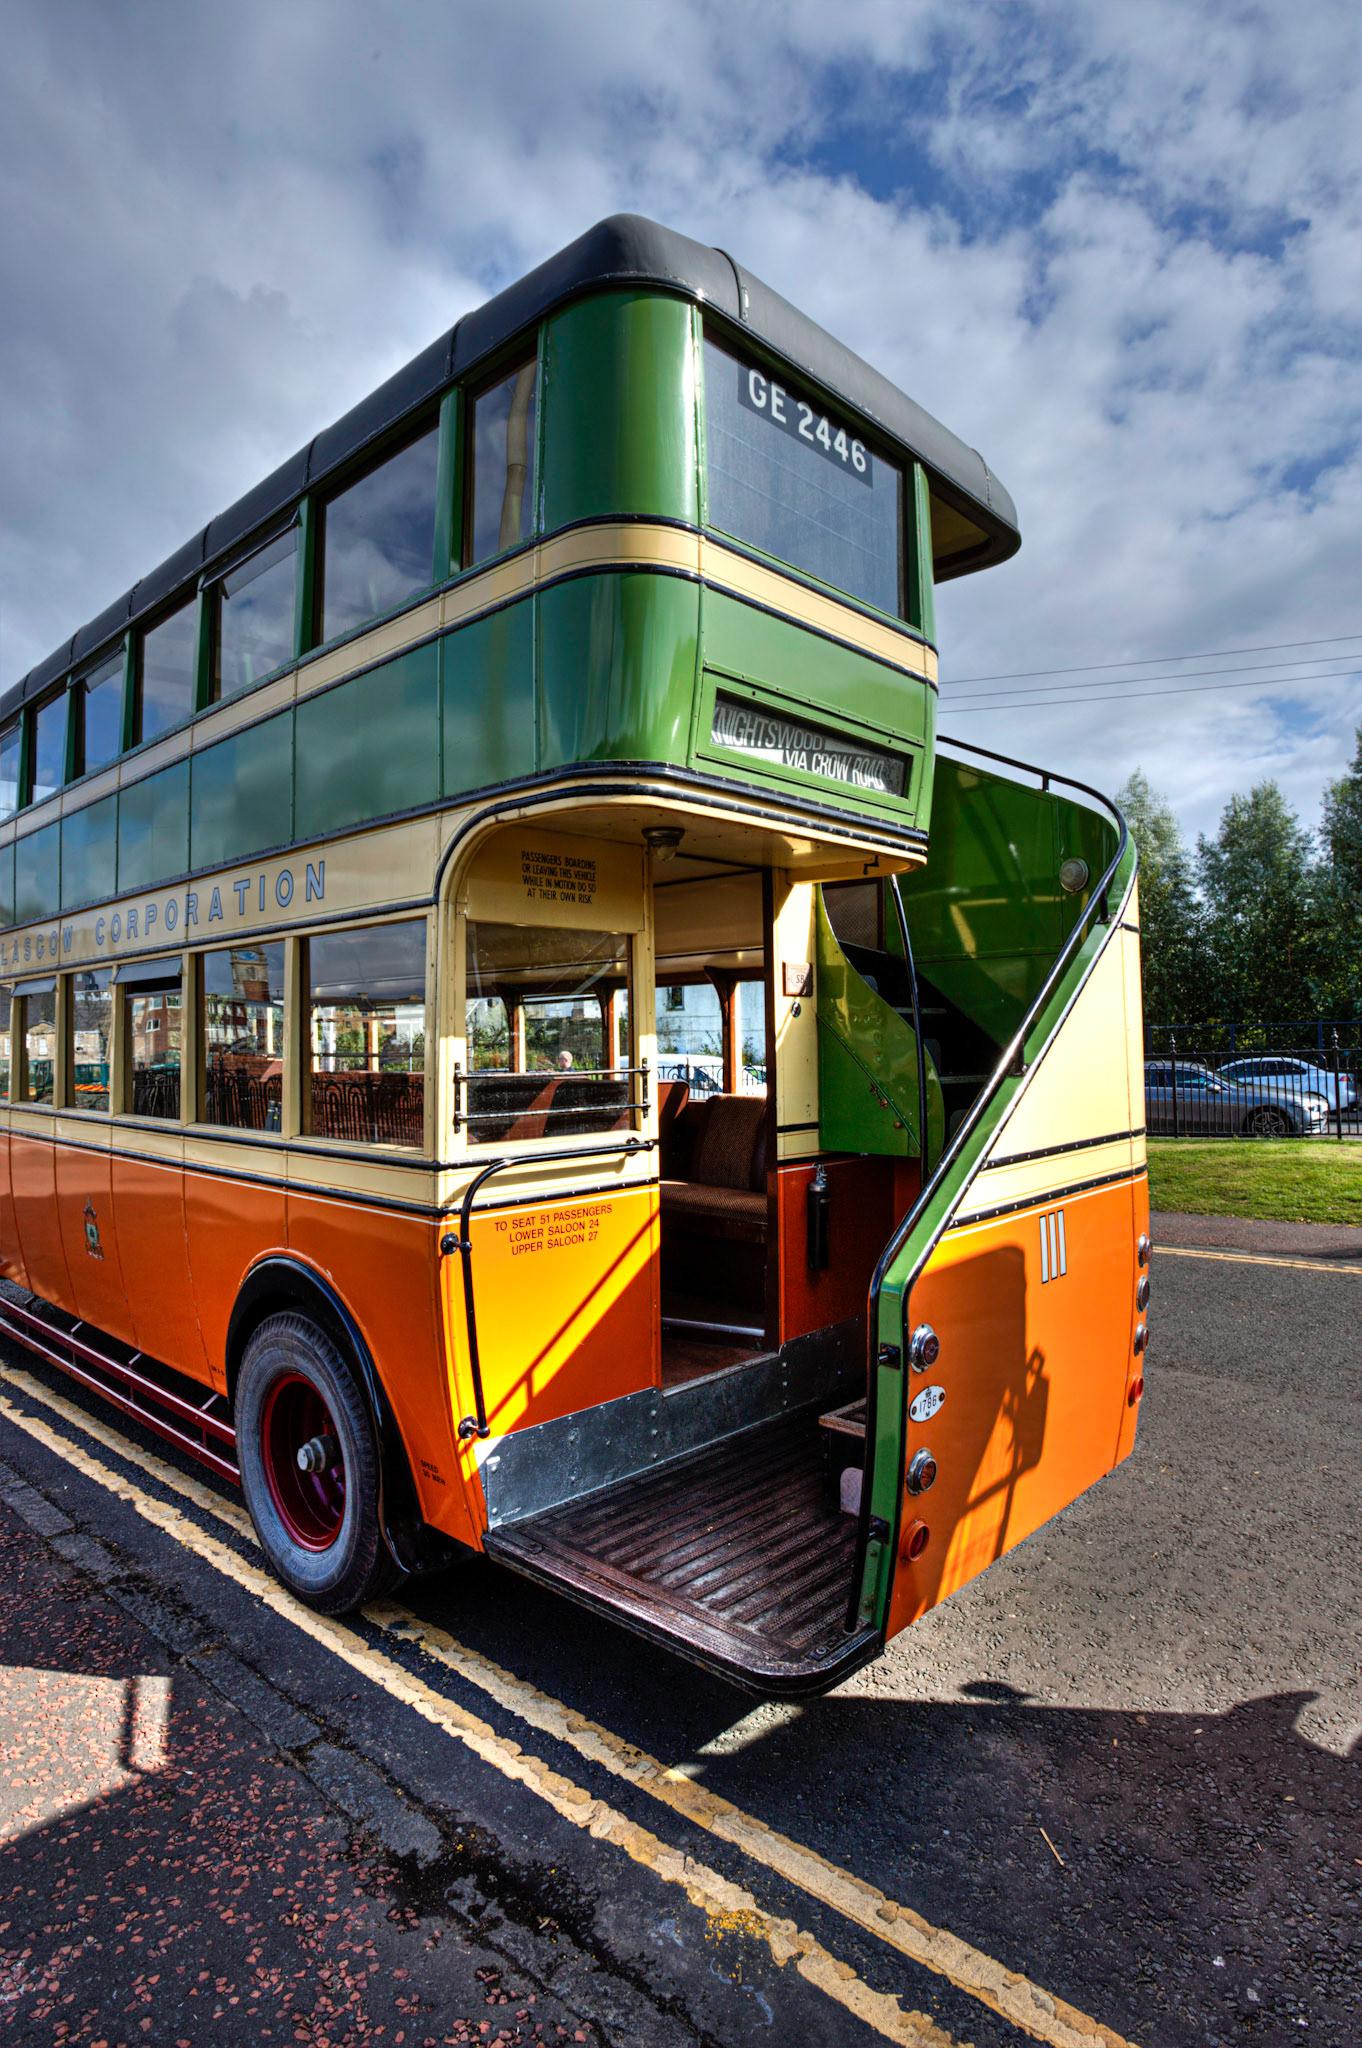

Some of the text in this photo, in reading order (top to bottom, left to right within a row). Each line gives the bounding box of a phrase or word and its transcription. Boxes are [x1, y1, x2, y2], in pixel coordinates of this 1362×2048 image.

[749, 369, 866, 473] GE 2446
[785, 750, 884, 790] VIA CROW ROAD
[521, 850, 596, 871] PASSENGERS BOARDING
[522, 863, 596, 882] OR LEAVING THIS VEHICLE
[522, 875, 596, 893] WHILE IN MOTION DO SO
[95, 861, 325, 946] CORPORATION
[527, 888, 592, 904] AT THEIR OWN RISK
[494, 1204, 612, 1231] TO SEAT 51 PASSENGERS
[509, 1219, 599, 1242] LOWER SALOON 24
[511, 1231, 598, 1255] UPPER SALOON 27
